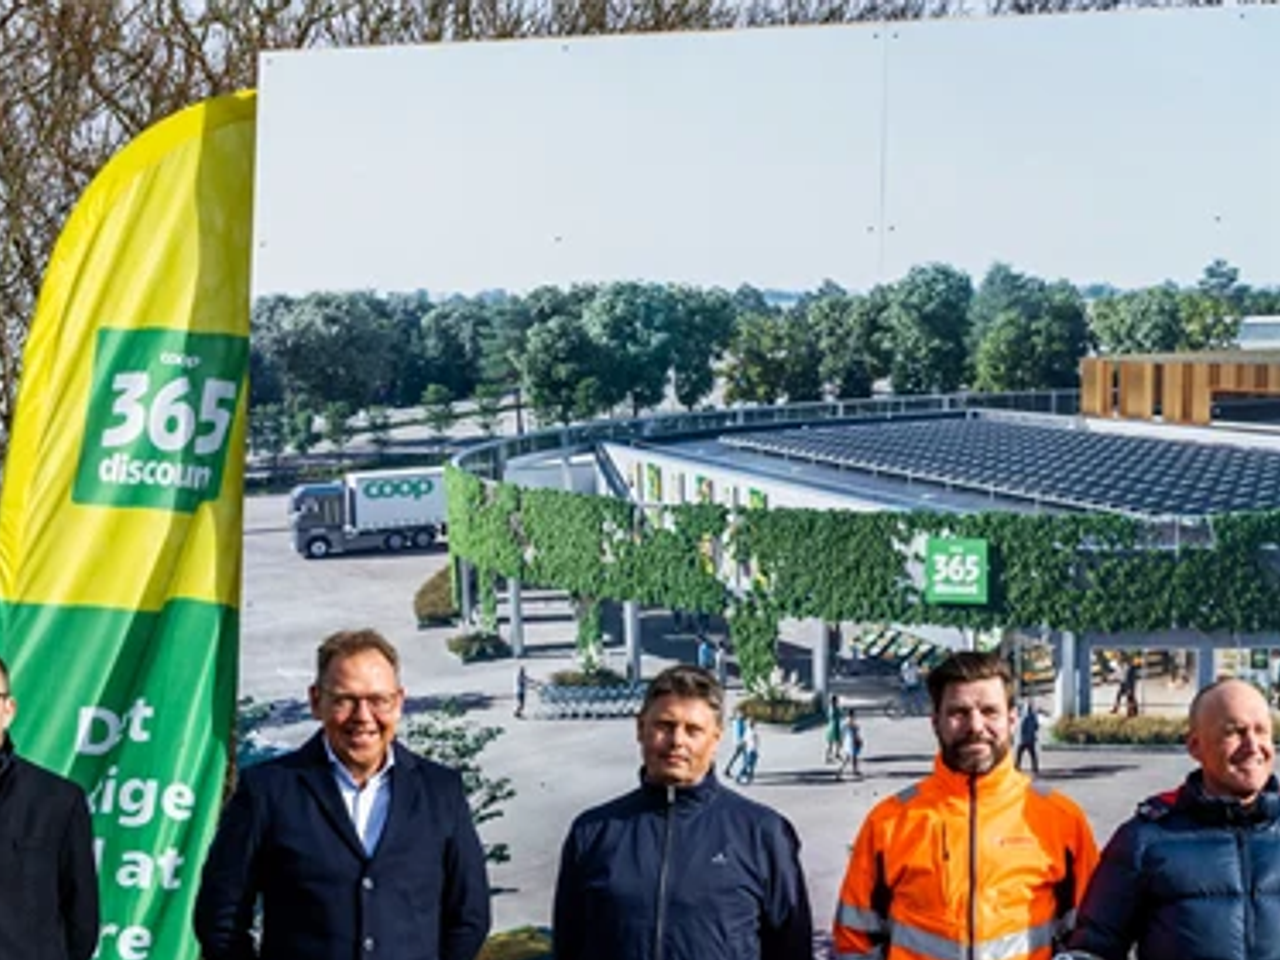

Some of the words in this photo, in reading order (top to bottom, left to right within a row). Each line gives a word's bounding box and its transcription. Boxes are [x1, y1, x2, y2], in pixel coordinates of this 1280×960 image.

[101, 371, 236, 455] 365
[98, 452, 212, 490] discoun
[363, 479, 433, 501] coop
[932, 554, 980, 582] 365
[77, 697, 155, 755] Dt
[88, 765, 195, 827] ige
[116, 846, 183, 889] at
